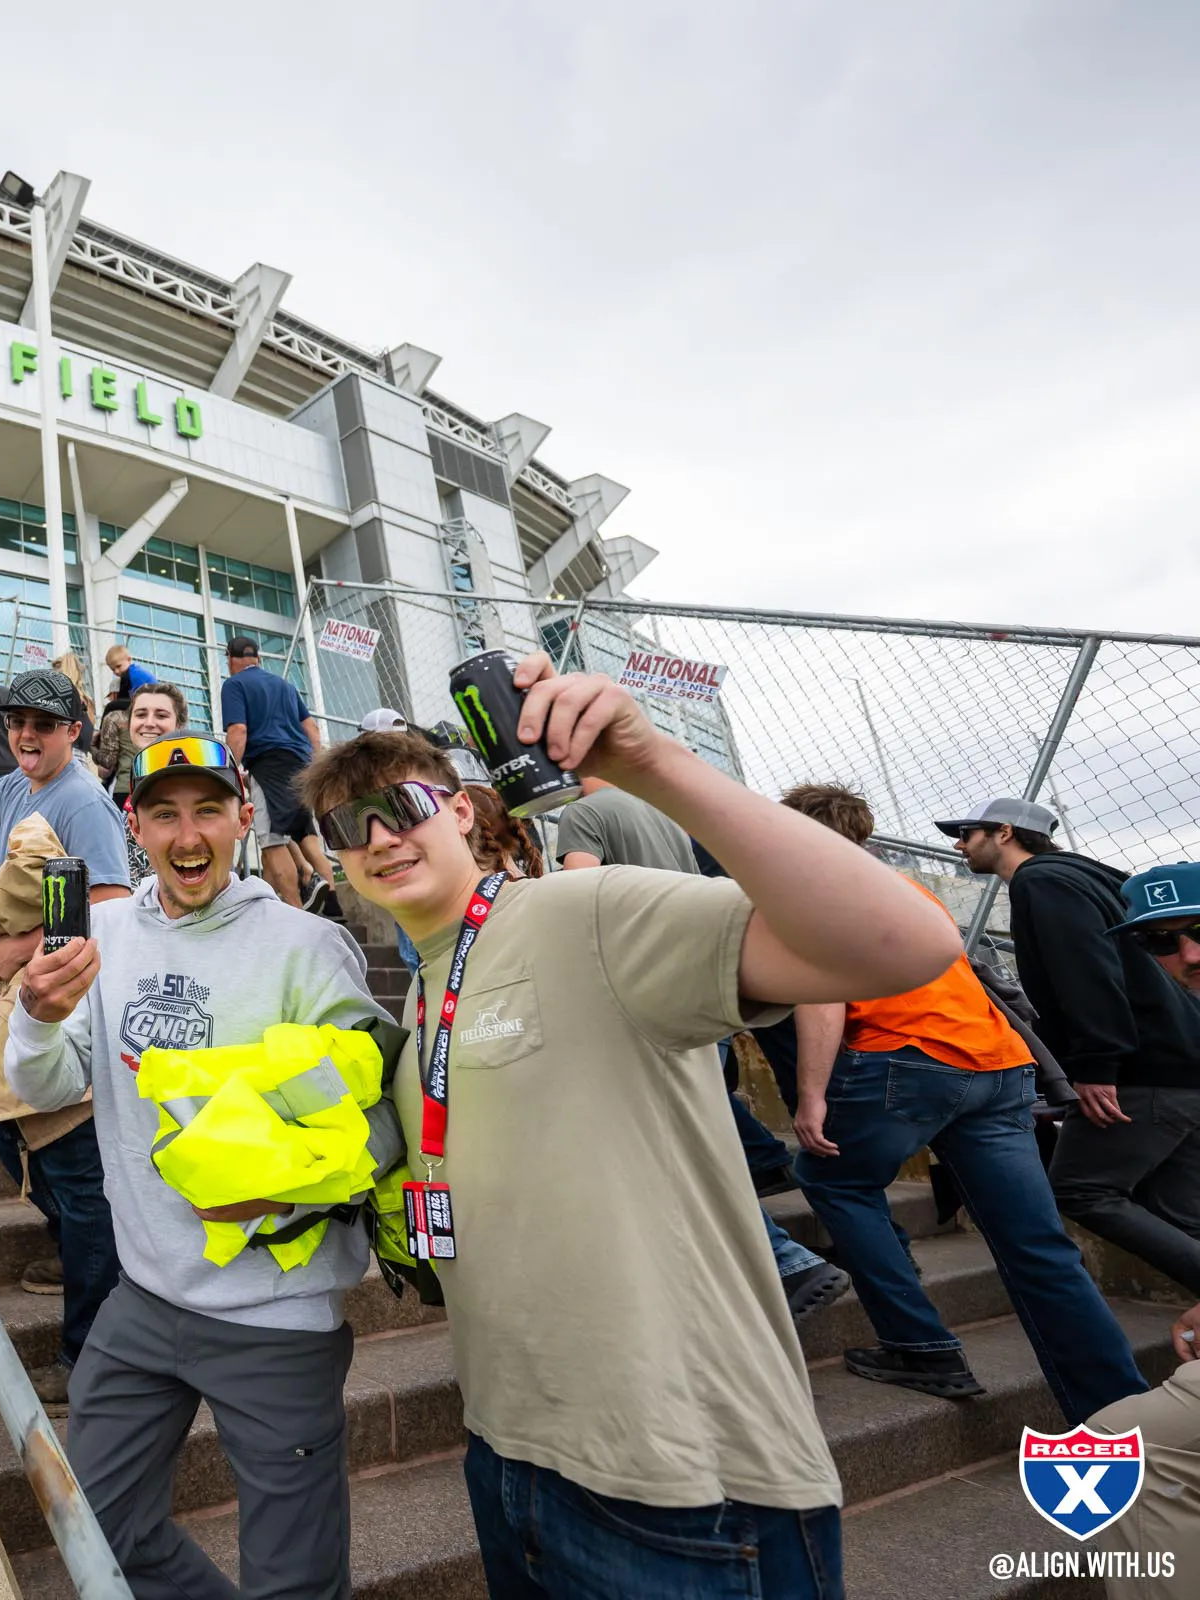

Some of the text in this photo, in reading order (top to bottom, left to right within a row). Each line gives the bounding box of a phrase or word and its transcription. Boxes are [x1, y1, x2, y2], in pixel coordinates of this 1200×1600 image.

[11, 341, 203, 439] FIELD
[325, 620, 376, 647] NATIONAL
[622, 670, 718, 694] RENT-A-FENCE
[625, 651, 720, 688] NATIONAL
[619, 677, 713, 703] 800-352-5675
[128, 1011, 205, 1046] GNCC
[460, 1017, 525, 1042] FIELDSTONE
[430, 1193, 441, 1209] $20
[431, 1210, 443, 1228] OFF
